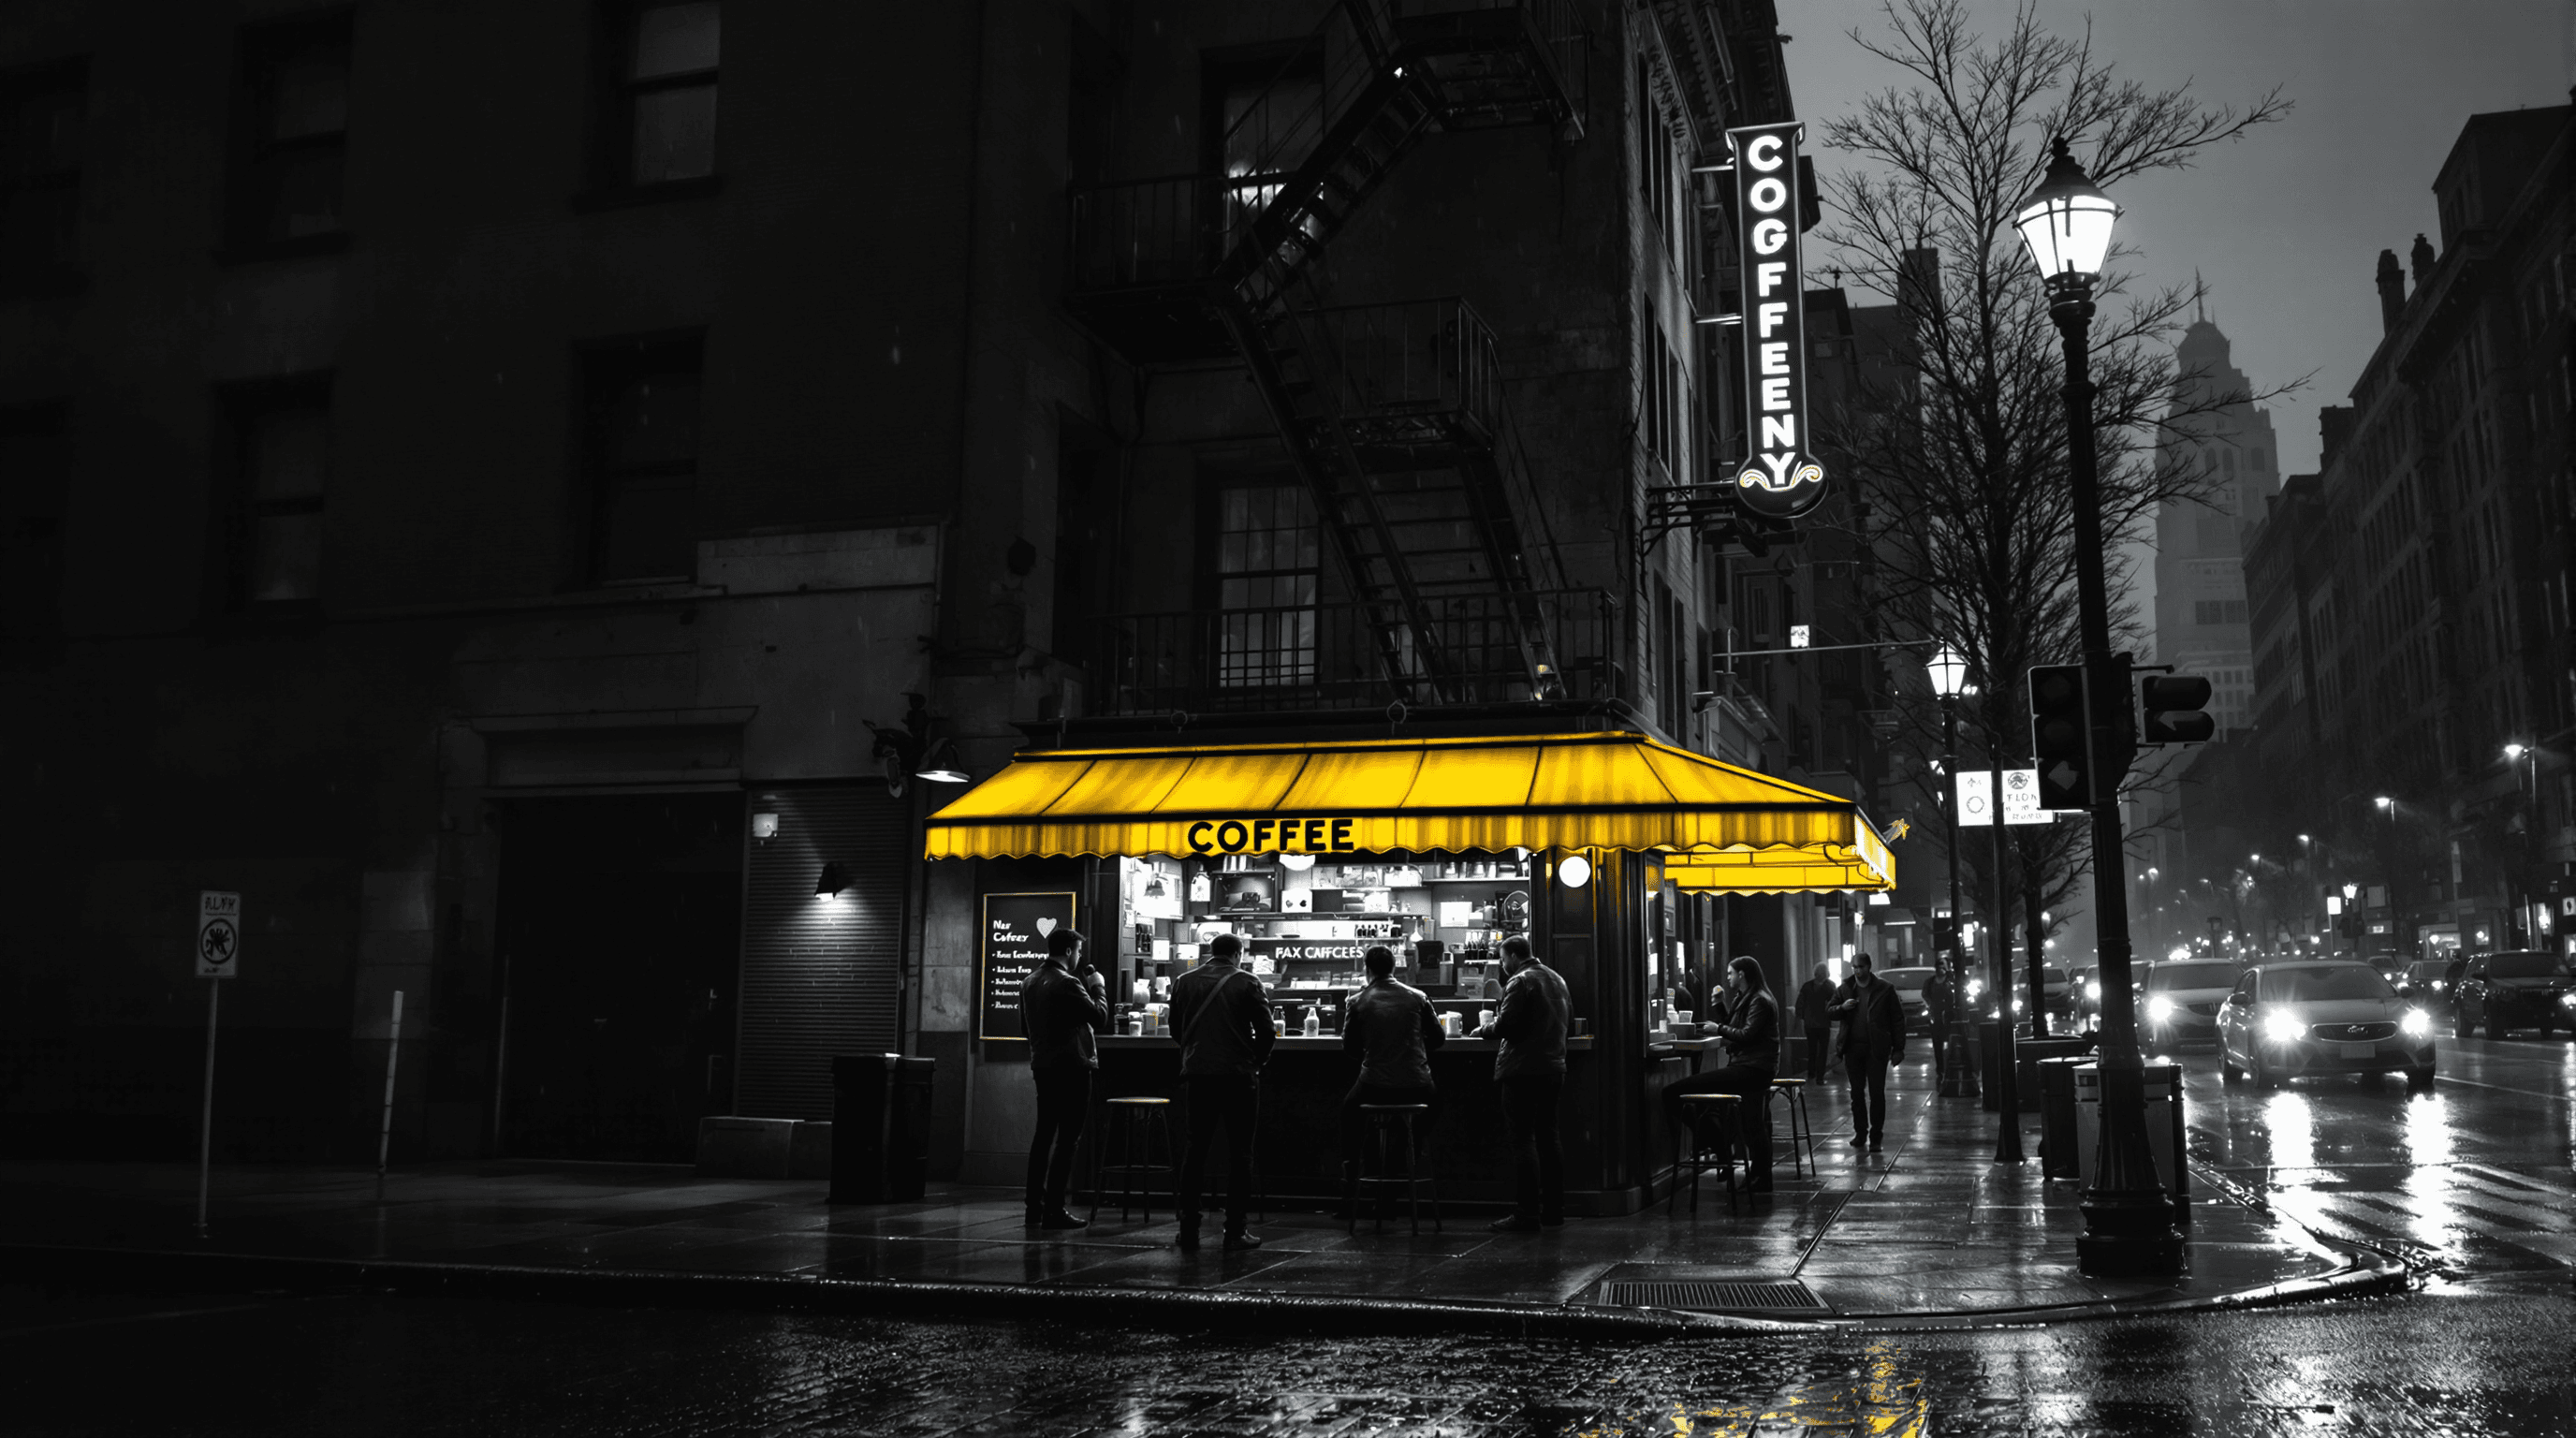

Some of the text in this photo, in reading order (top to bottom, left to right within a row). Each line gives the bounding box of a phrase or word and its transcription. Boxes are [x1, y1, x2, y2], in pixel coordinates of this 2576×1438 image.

[1748, 135, 1795, 485] COGFFEENY
[1188, 819, 1354, 852] COFFEE
[1275, 946, 1302, 959] FAX
